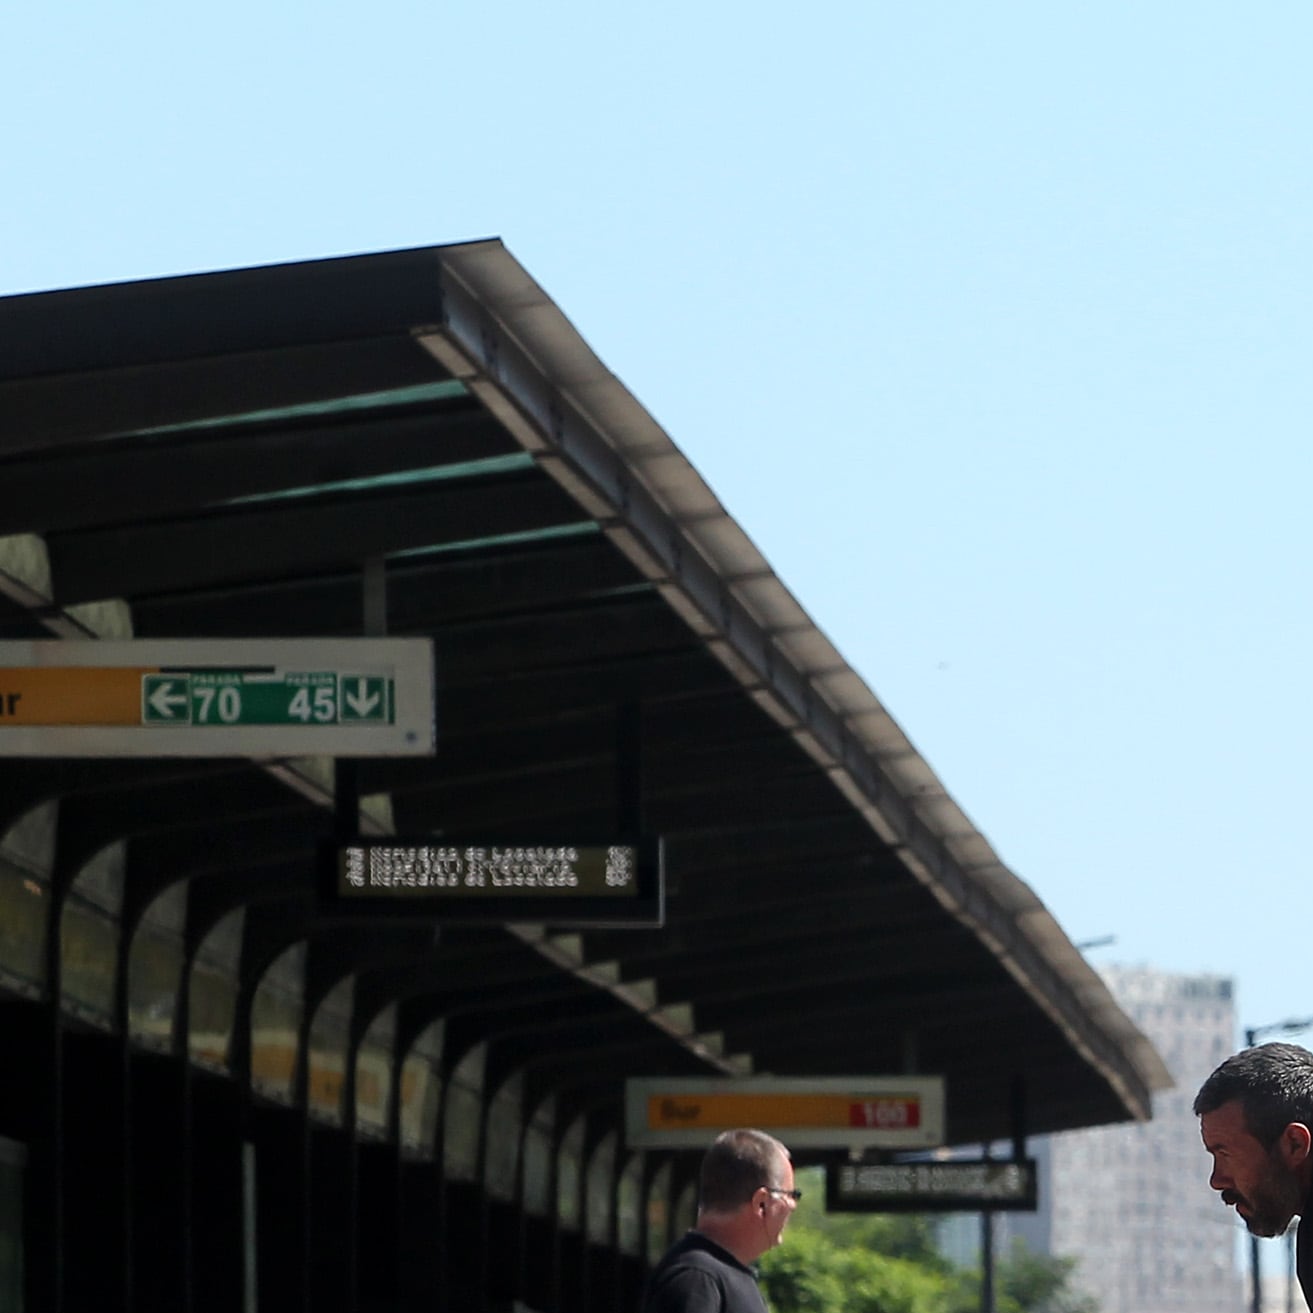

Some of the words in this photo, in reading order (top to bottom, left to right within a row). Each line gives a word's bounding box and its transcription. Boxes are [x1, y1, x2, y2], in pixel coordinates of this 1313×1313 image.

[0, 693, 22, 716] r
[193, 687, 241, 722] 70
[287, 687, 336, 722] 45
